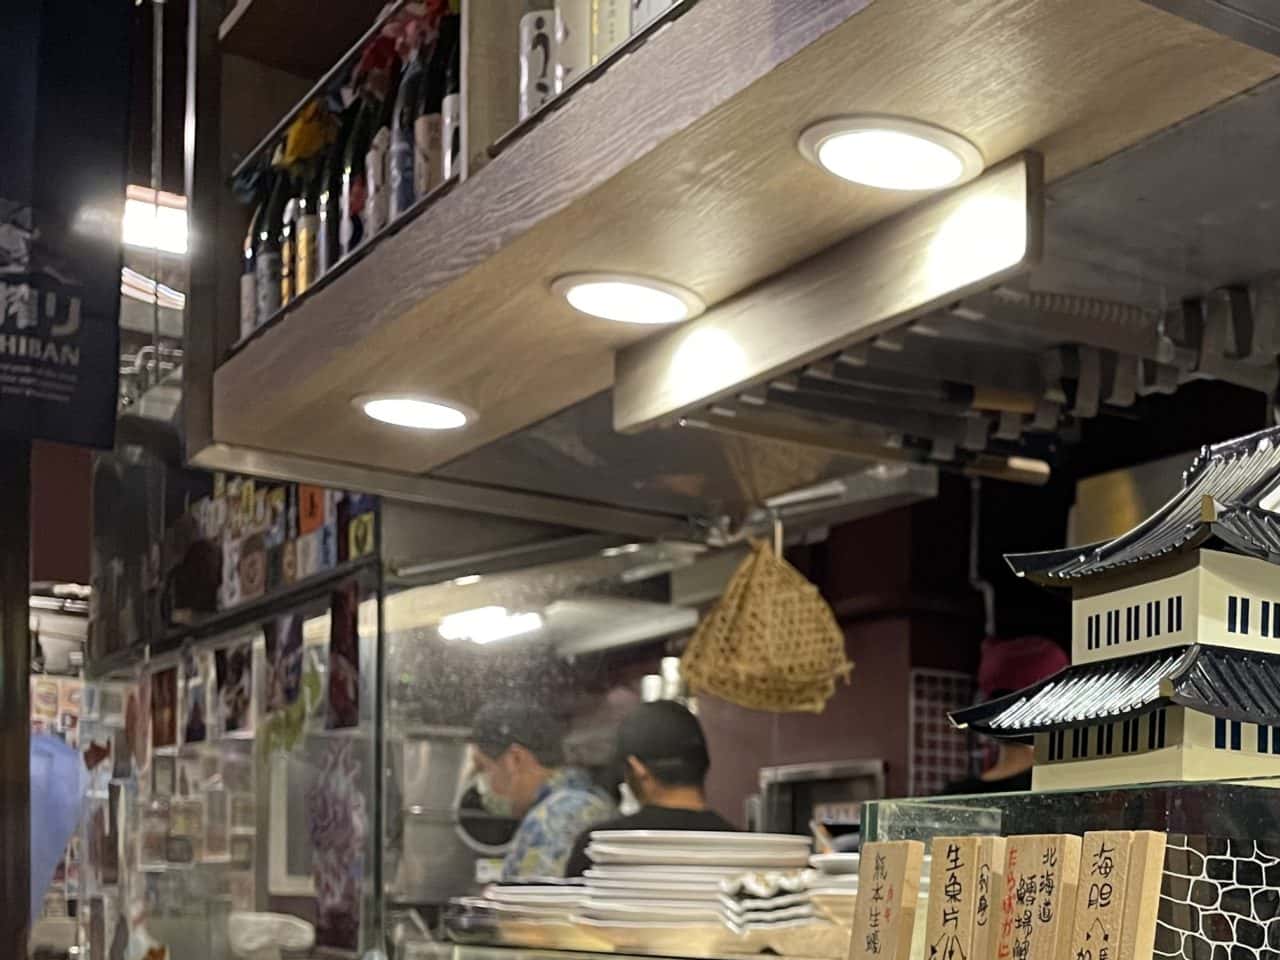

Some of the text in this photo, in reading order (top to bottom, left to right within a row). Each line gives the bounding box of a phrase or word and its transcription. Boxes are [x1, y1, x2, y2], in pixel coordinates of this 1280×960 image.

[942, 844, 965, 930] 生魚片
[1038, 847, 1057, 923] 北海道
